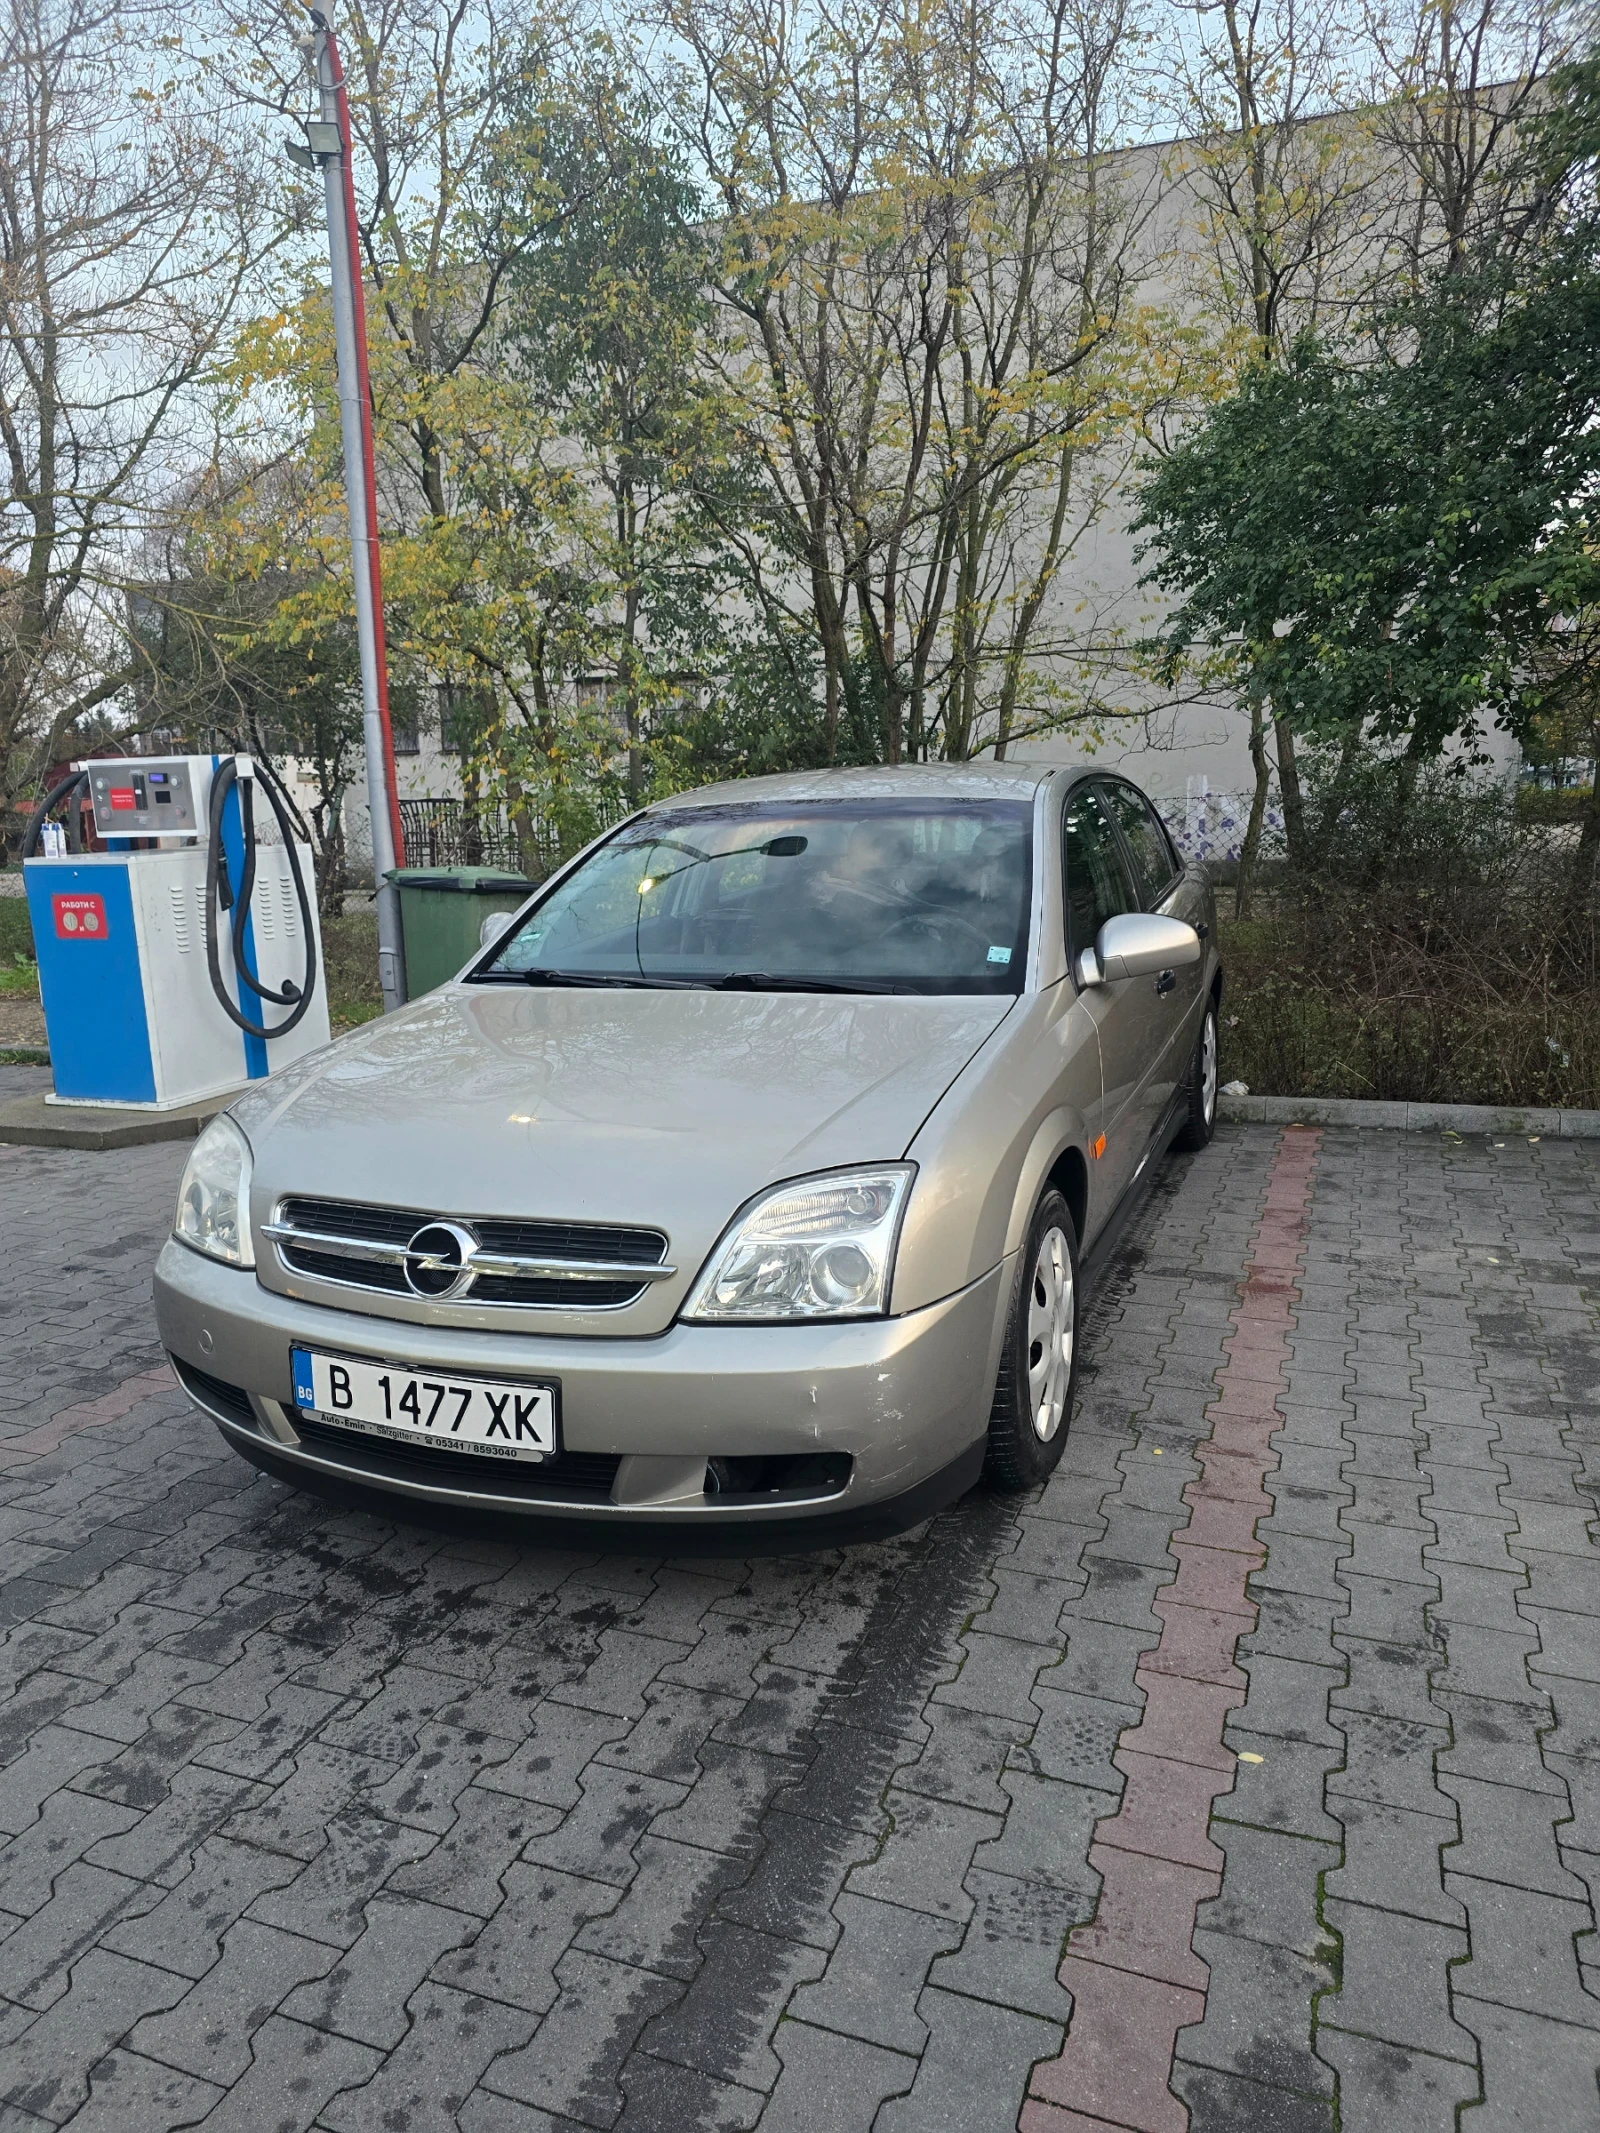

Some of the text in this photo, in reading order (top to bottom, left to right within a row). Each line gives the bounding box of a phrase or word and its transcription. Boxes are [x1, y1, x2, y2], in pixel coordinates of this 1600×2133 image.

[61, 901, 96, 909] РАБОТИ С
[298, 1385, 313, 1401] BG
[329, 1364, 543, 1443] B 1477 XK
[376, 1426, 413, 1440] Salzgitter
[435, 1439, 464, 1451] 05341
[473, 1444, 517, 1458] 8593040
